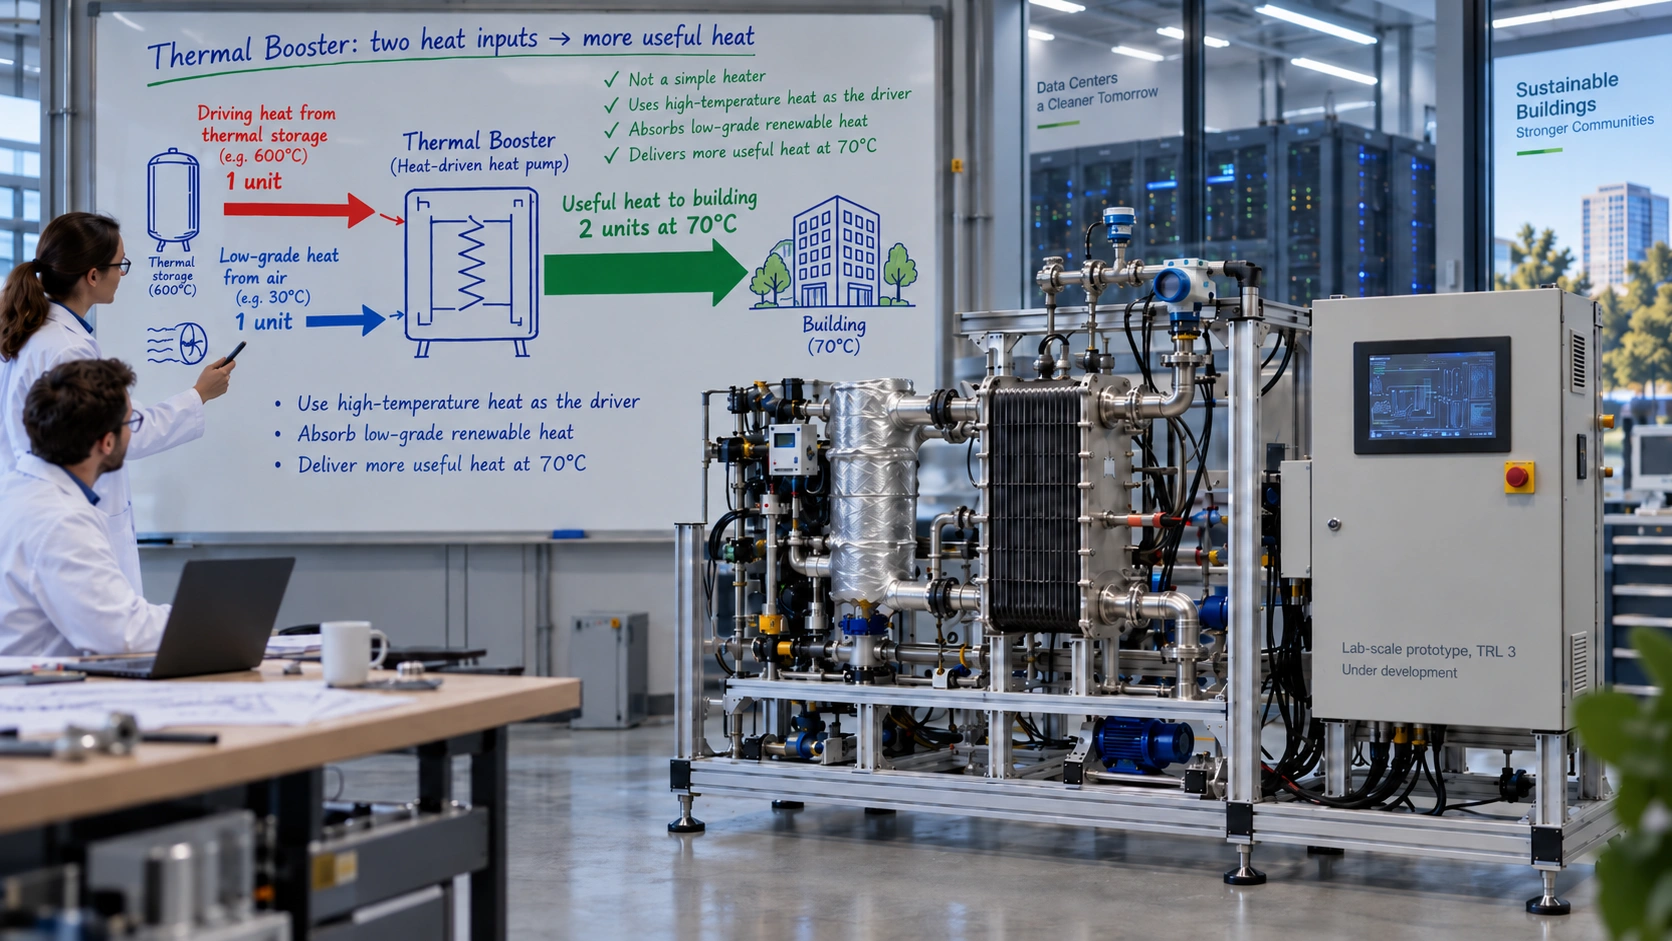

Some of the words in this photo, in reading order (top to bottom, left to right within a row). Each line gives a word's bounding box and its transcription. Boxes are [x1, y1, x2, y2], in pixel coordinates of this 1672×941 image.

[148, 36, 251, 69] Thermal
[265, 33, 357, 60] Booster:
[370, 30, 409, 52] two
[421, 26, 465, 50] heat
[477, 27, 538, 57] inputs
[584, 33, 632, 46] more
[643, 24, 701, 48] useful
[712, 24, 754, 45] heat
[629, 72, 653, 86] Not
[661, 76, 668, 85] a
[675, 69, 716, 90] simple
[723, 69, 766, 83] heater
[1037, 81, 1065, 93] Data
[1069, 74, 1118, 89] Centers
[1516, 72, 1618, 97] Sustainable
[629, 98, 658, 111] Uses
[666, 94, 780, 114] high-temperature
[788, 90, 816, 104] heat
[823, 94, 836, 103] as
[844, 87, 864, 102] the
[871, 86, 912, 100] driver
[1037, 103, 1044, 112] a
[1048, 96, 1094, 110] Cleaner
[1098, 88, 1158, 103] Tomorrow
[1516, 100, 1596, 119] Buildings
[198, 105, 252, 126] Driving
[260, 105, 292, 120] heat
[300, 104, 335, 120] from
[629, 120, 684, 136] Absorbs
[692, 117, 759, 137] low-grade
[766, 114, 832, 130] renewable
[840, 113, 868, 127] heat
[202, 126, 262, 142] thermal
[271, 128, 327, 147] storage
[1516, 125, 1568, 138] Stronger
[1572, 115, 1654, 132] Communities
[403, 130, 480, 150] Thermal
[490, 130, 556, 149] Booster
[220, 148, 247, 167] (e.g.
[630, 146, 685, 162] Delivers
[693, 149, 726, 158] more
[733, 141, 773, 159] useful
[781, 141, 810, 155] heat
[817, 141, 830, 154] at
[391, 157, 482, 177] (Heat-driven
[490, 156, 519, 170] heat
[526, 154, 568, 176] pump)
[227, 172, 234, 190] 1
[245, 172, 282, 189] unit
[563, 192, 616, 213] Useful
[625, 192, 660, 209] heat
[668, 192, 685, 207] to
[693, 188, 757, 210] building
[579, 219, 592, 238] 2
[602, 219, 649, 236] units
[658, 217, 677, 234] at
[149, 256, 194, 267] Thermal
[220, 246, 299, 268] Low-grade
[307, 246, 339, 262] heat
[153, 271, 193, 284] storage
[224, 268, 259, 285] from
[267, 270, 287, 284] air
[236, 290, 262, 308] (e.g.
[236, 313, 244, 330] 1
[255, 312, 292, 330] unit
[803, 315, 865, 337] Building
[298, 395, 328, 411] Use
[338, 393, 479, 417] high-temperature
[488, 392, 522, 409] heat
[531, 399, 547, 409] as
[556, 392, 582, 408] the
[590, 391, 640, 408] driver
[298, 424, 355, 441] Absorb
[365, 423, 443, 447] low-grade
[452, 423, 530, 440] renewable
[540, 422, 573, 439] heat
[299, 455, 357, 473] Deliver
[366, 462, 404, 472] more
[414, 454, 461, 475] useful
[471, 454, 505, 471] heat
[514, 457, 530, 471] at
[1342, 642, 1402, 654] Lab-scale
[1407, 645, 1471, 659] prototype,
[1476, 645, 1503, 657] TRL
[1508, 646, 1516, 657] 3
[1342, 664, 1377, 675] Under
[1381, 665, 1457, 680] development
